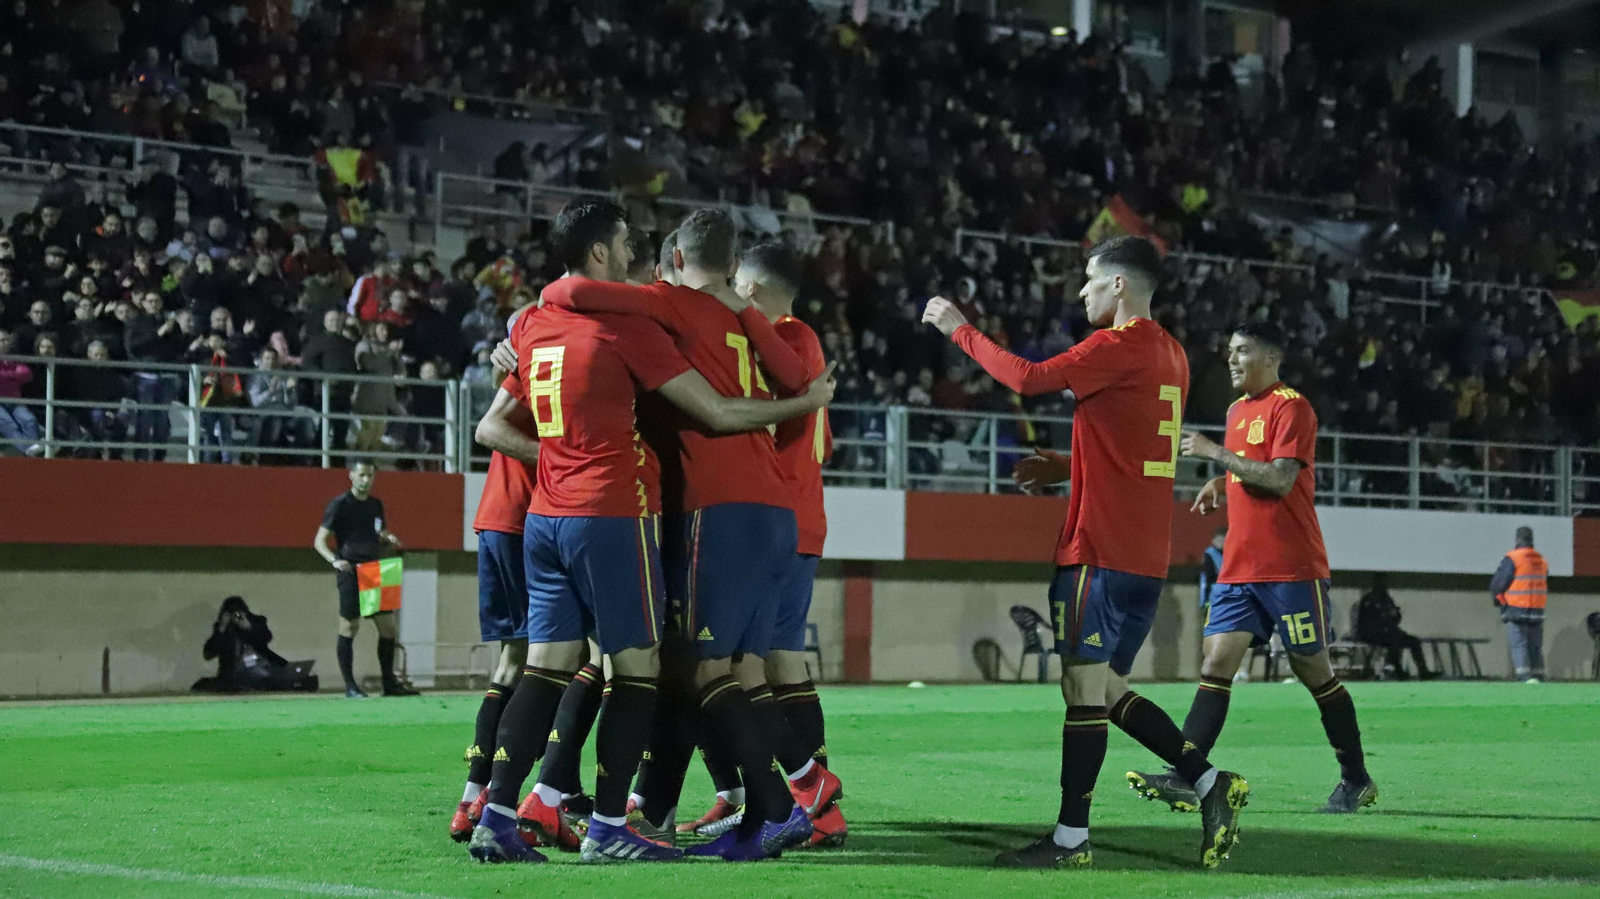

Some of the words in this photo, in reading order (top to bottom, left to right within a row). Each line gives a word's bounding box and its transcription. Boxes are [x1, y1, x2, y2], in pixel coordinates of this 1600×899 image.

[529, 345, 565, 438] 8
[1143, 385, 1181, 479] 3
[1281, 611, 1317, 645] 16
